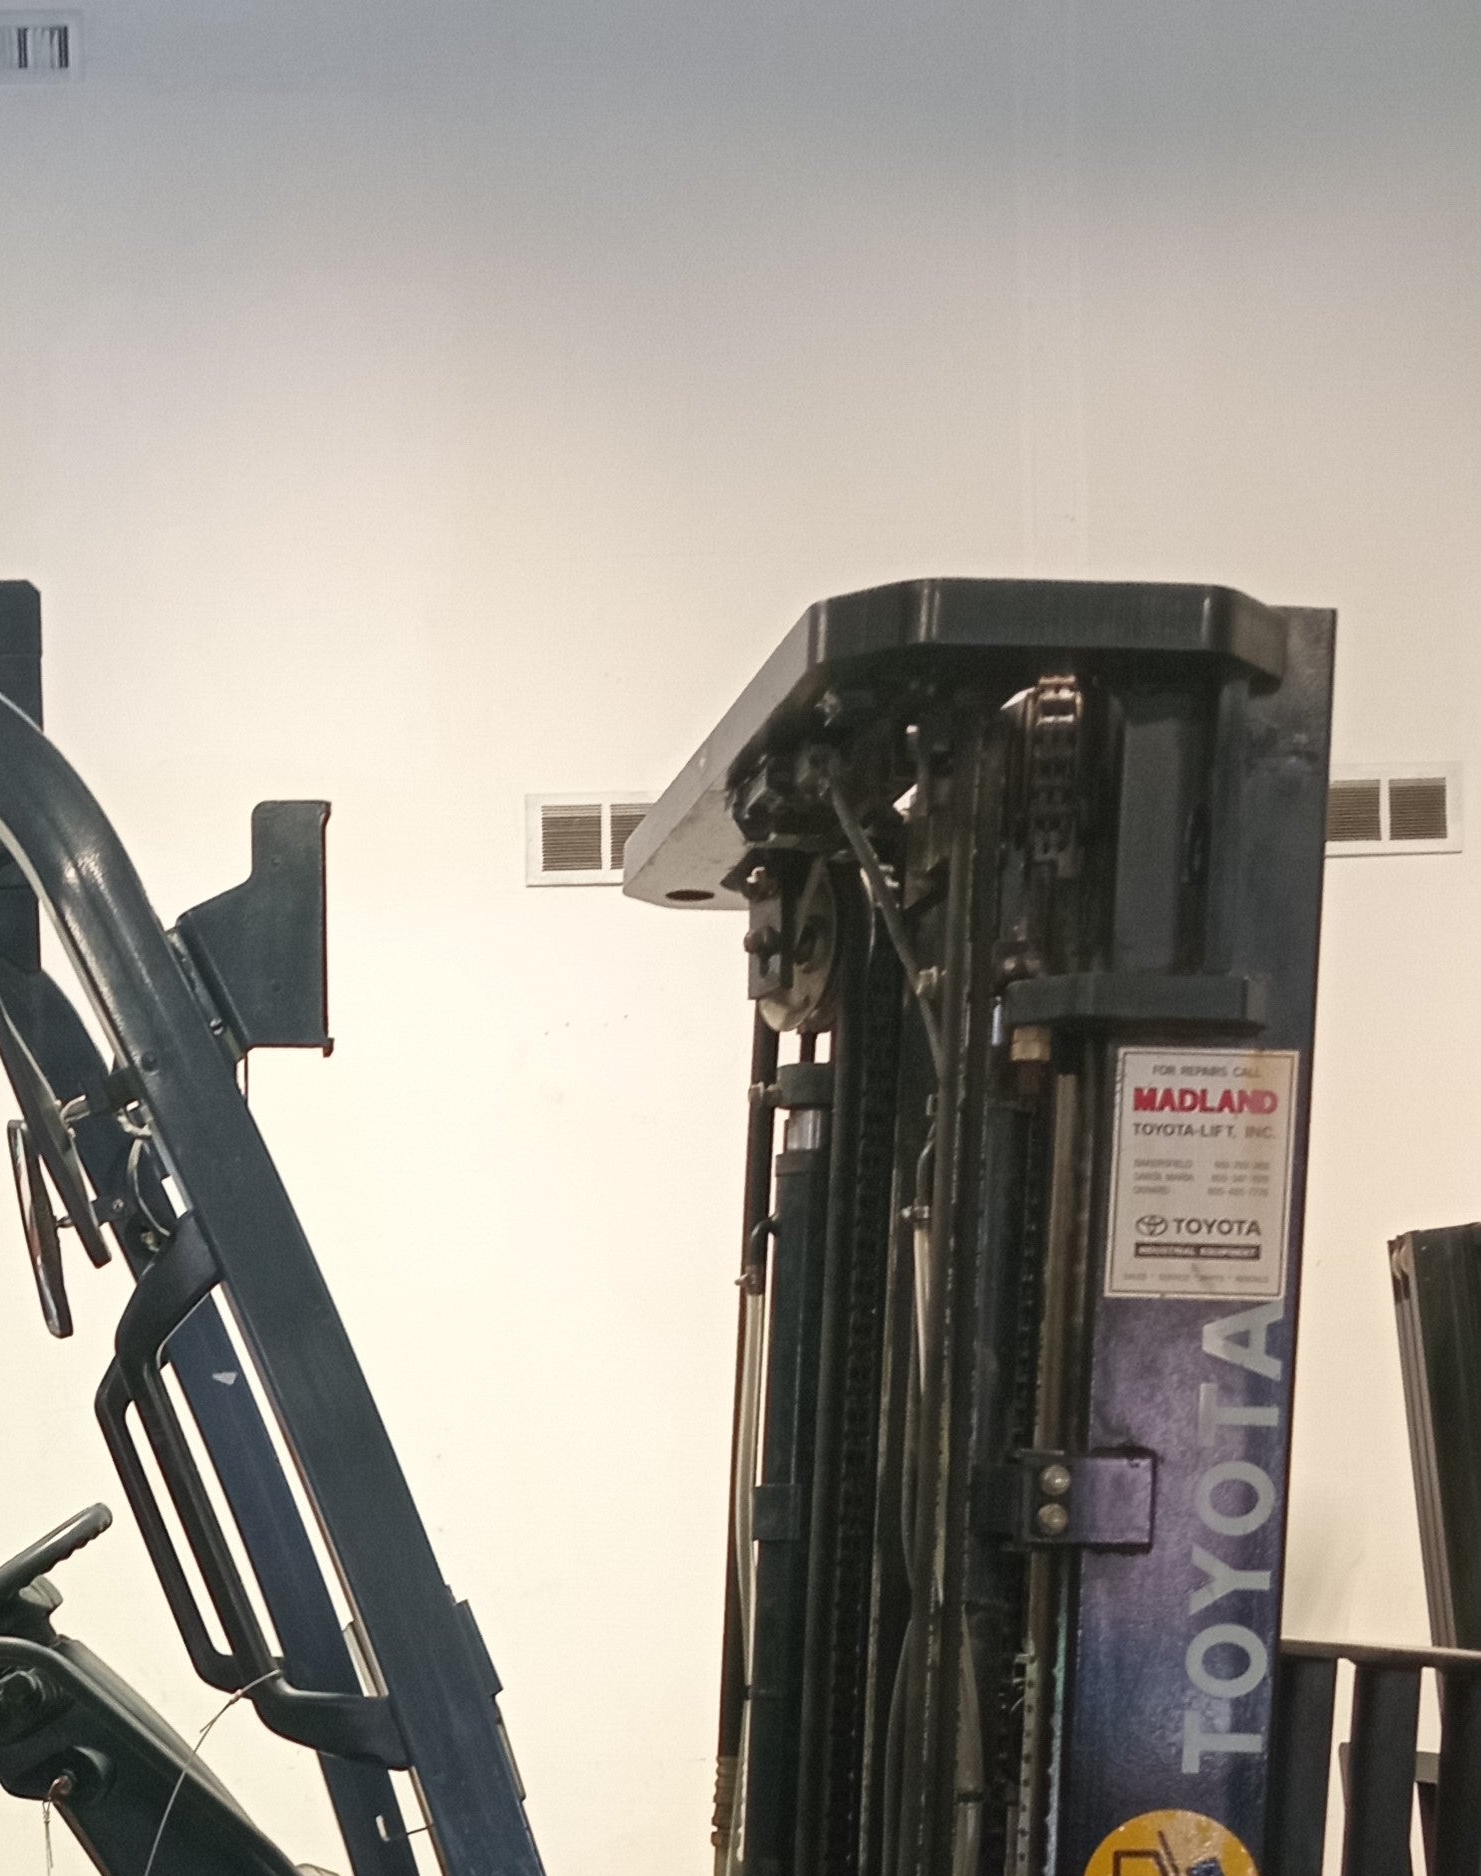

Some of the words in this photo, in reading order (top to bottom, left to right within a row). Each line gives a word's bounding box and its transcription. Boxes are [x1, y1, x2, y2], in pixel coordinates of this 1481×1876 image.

[1152, 1064, 1176, 1076] FOR
[1180, 1065, 1227, 1077] REPAIRS
[1232, 1066, 1261, 1078] CALL
[1132, 1086, 1279, 1115] MADLAND
[1173, 1217, 1262, 1236] TOYOTA
[1181, 1301, 1284, 1774] TOYOTA
